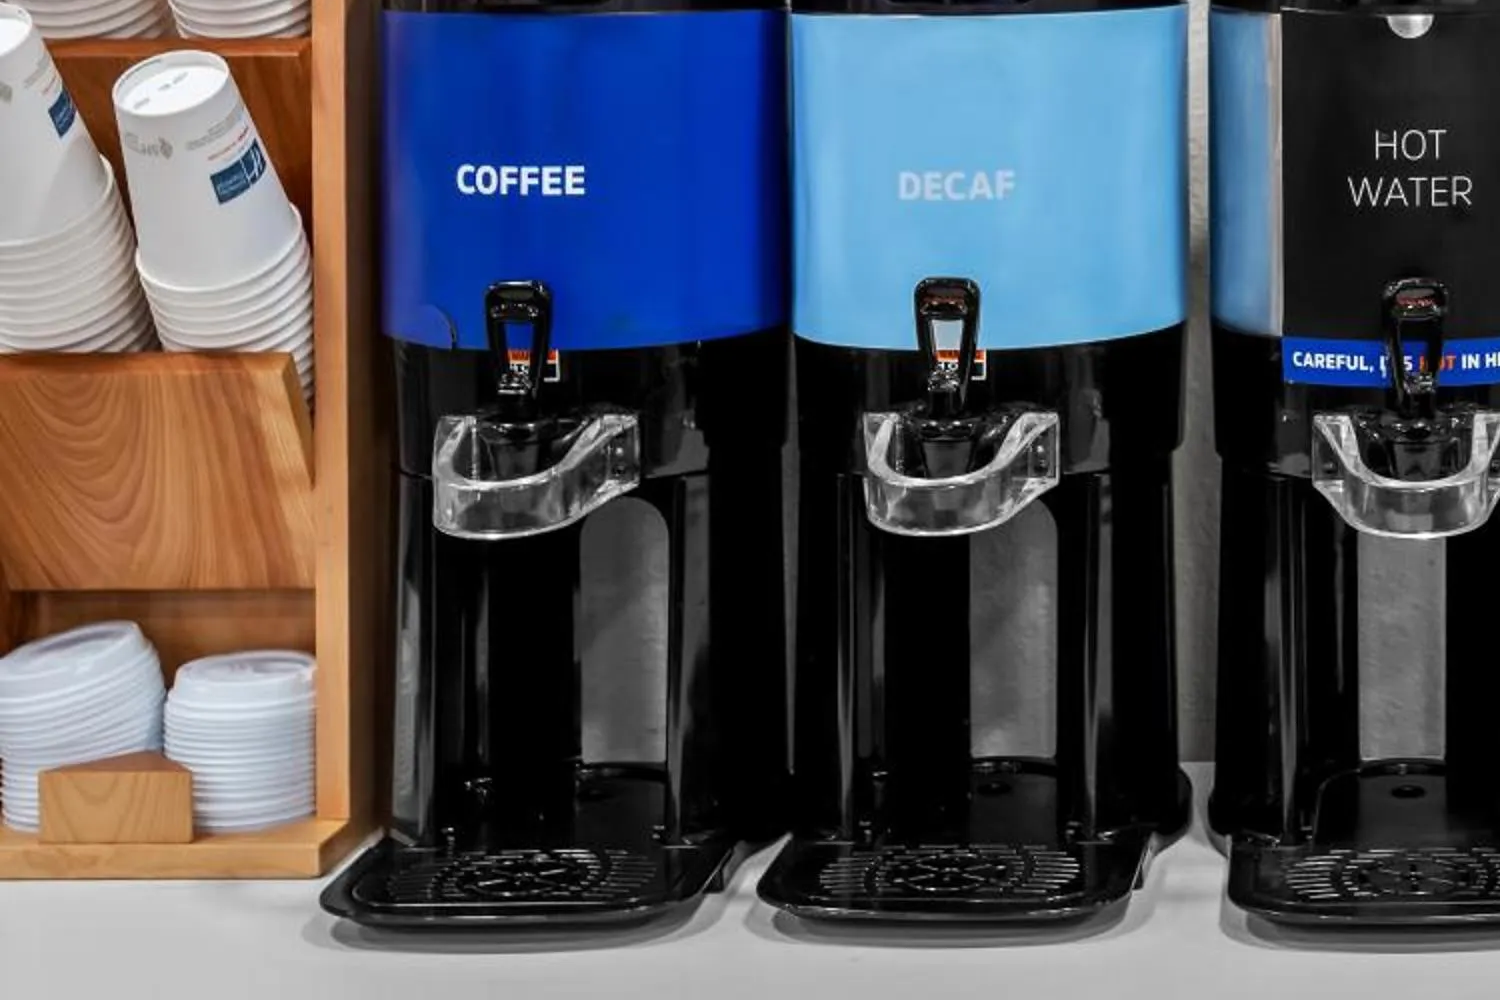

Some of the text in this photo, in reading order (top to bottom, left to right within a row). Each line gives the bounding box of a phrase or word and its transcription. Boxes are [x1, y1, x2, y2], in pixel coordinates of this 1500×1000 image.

[1374, 128, 1448, 161] HOT
[456, 163, 586, 196] COFFEE
[899, 169, 1016, 201] DECAF
[1346, 174, 1474, 208] WATER
[1292, 351, 1375, 374] CAREFUL,
[1461, 353, 1479, 370] IN
